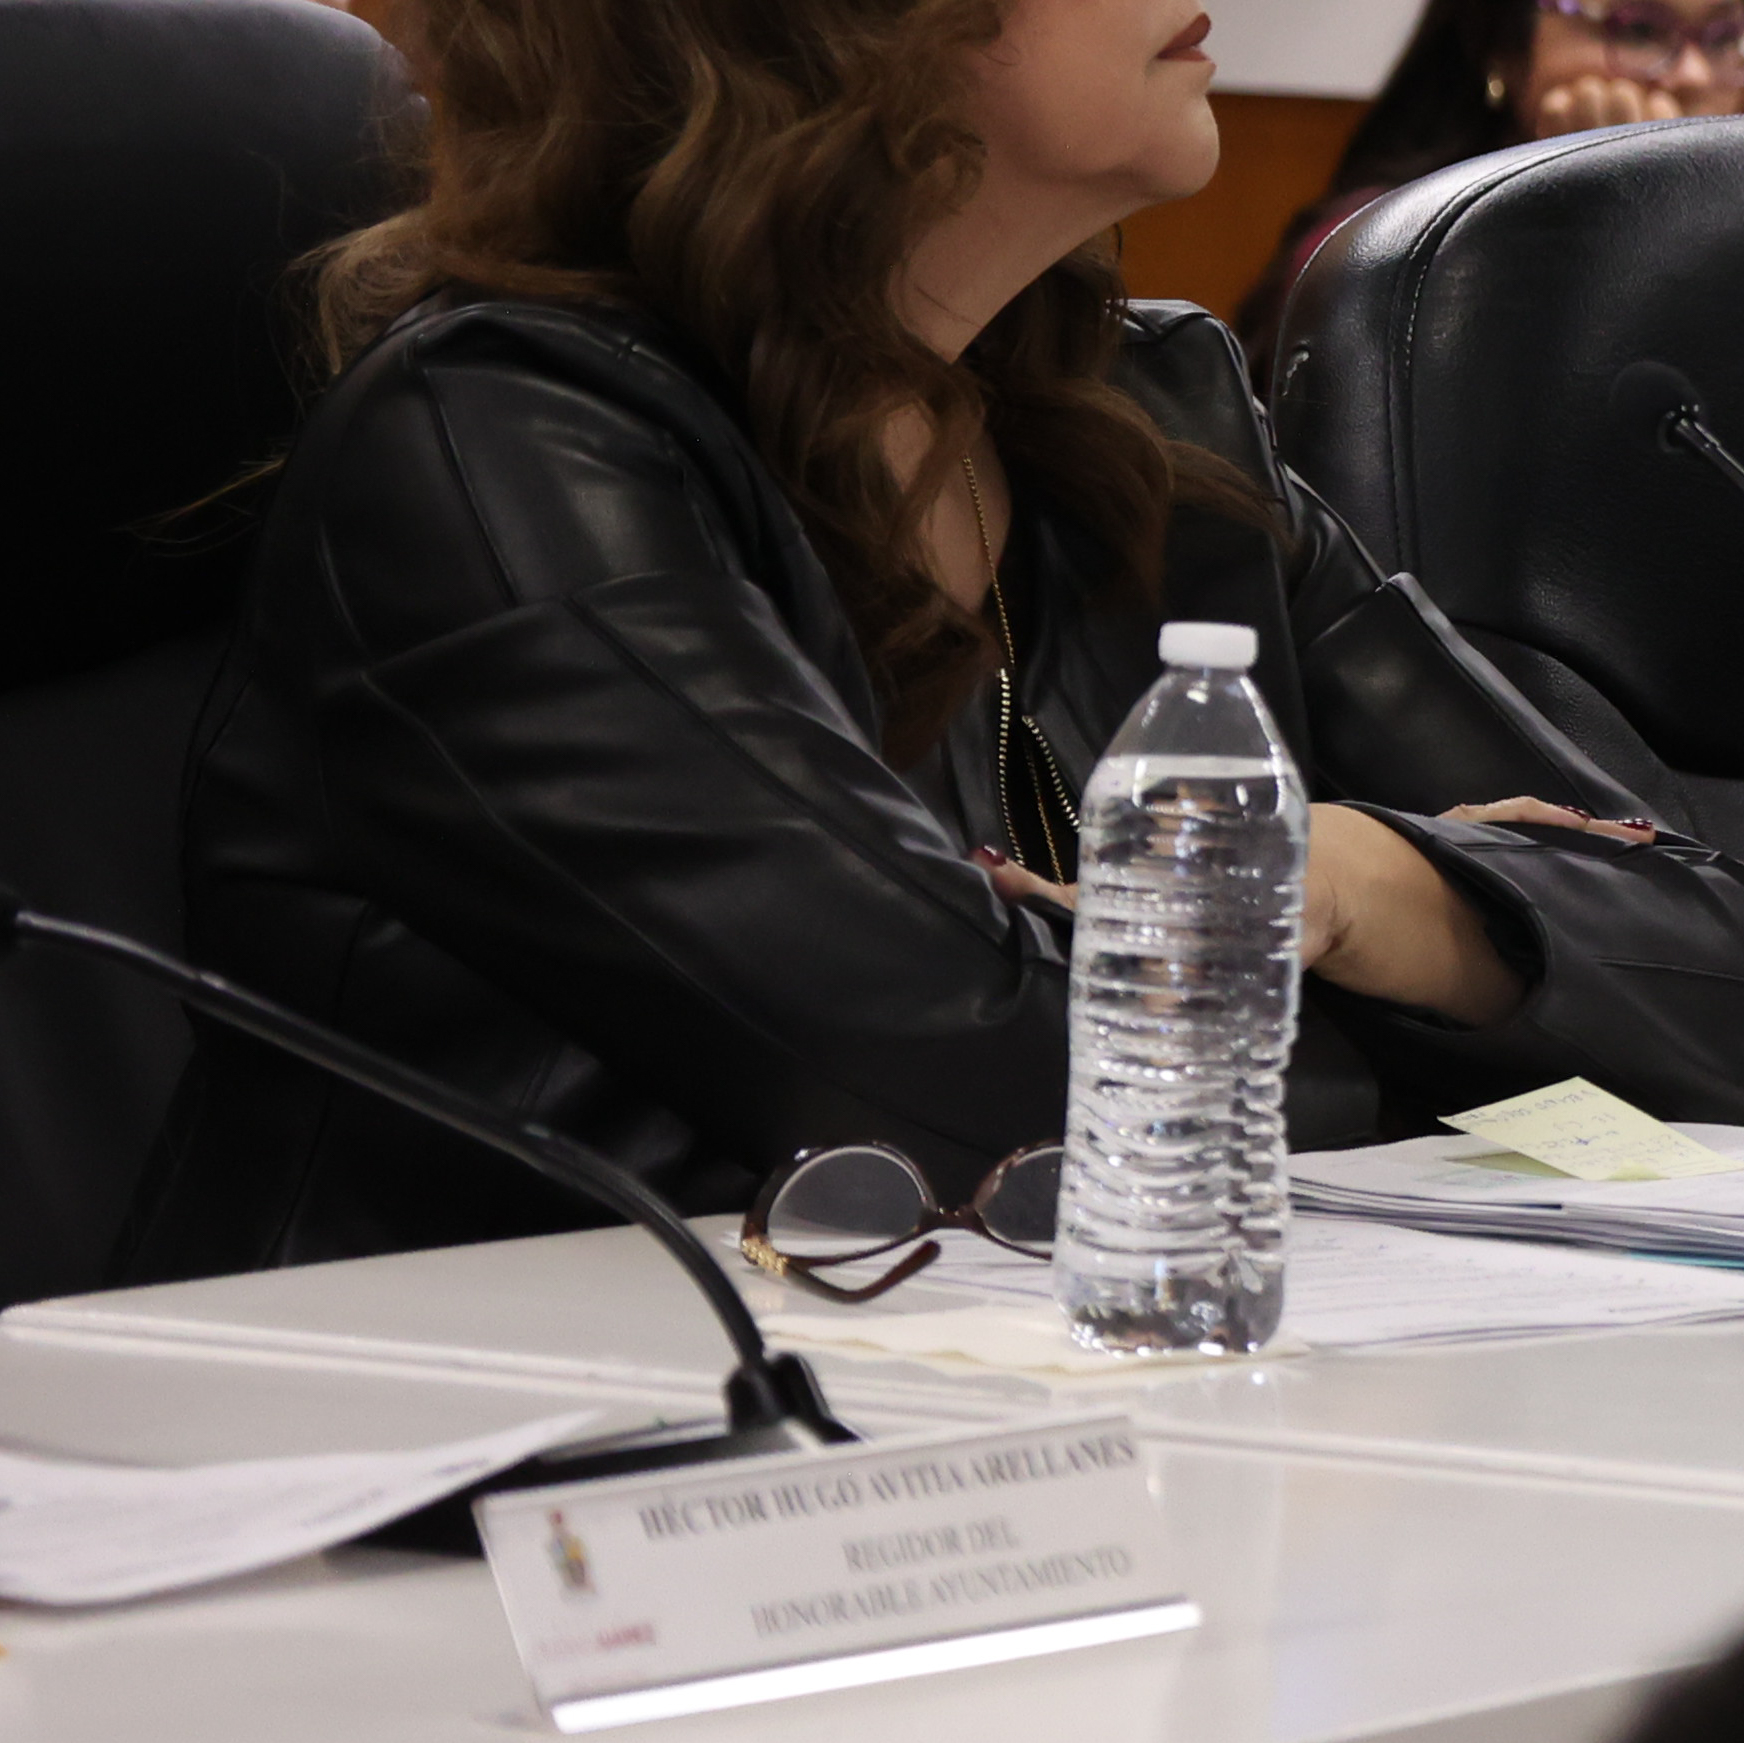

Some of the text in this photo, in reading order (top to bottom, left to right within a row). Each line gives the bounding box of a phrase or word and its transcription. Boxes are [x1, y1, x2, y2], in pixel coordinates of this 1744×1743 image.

[771, 1477, 863, 1518] HUGO
[842, 1515, 1020, 1574] REGIDOR DEL
[751, 1543, 1133, 1637] HONORABLE AYUNTAMIENTO
